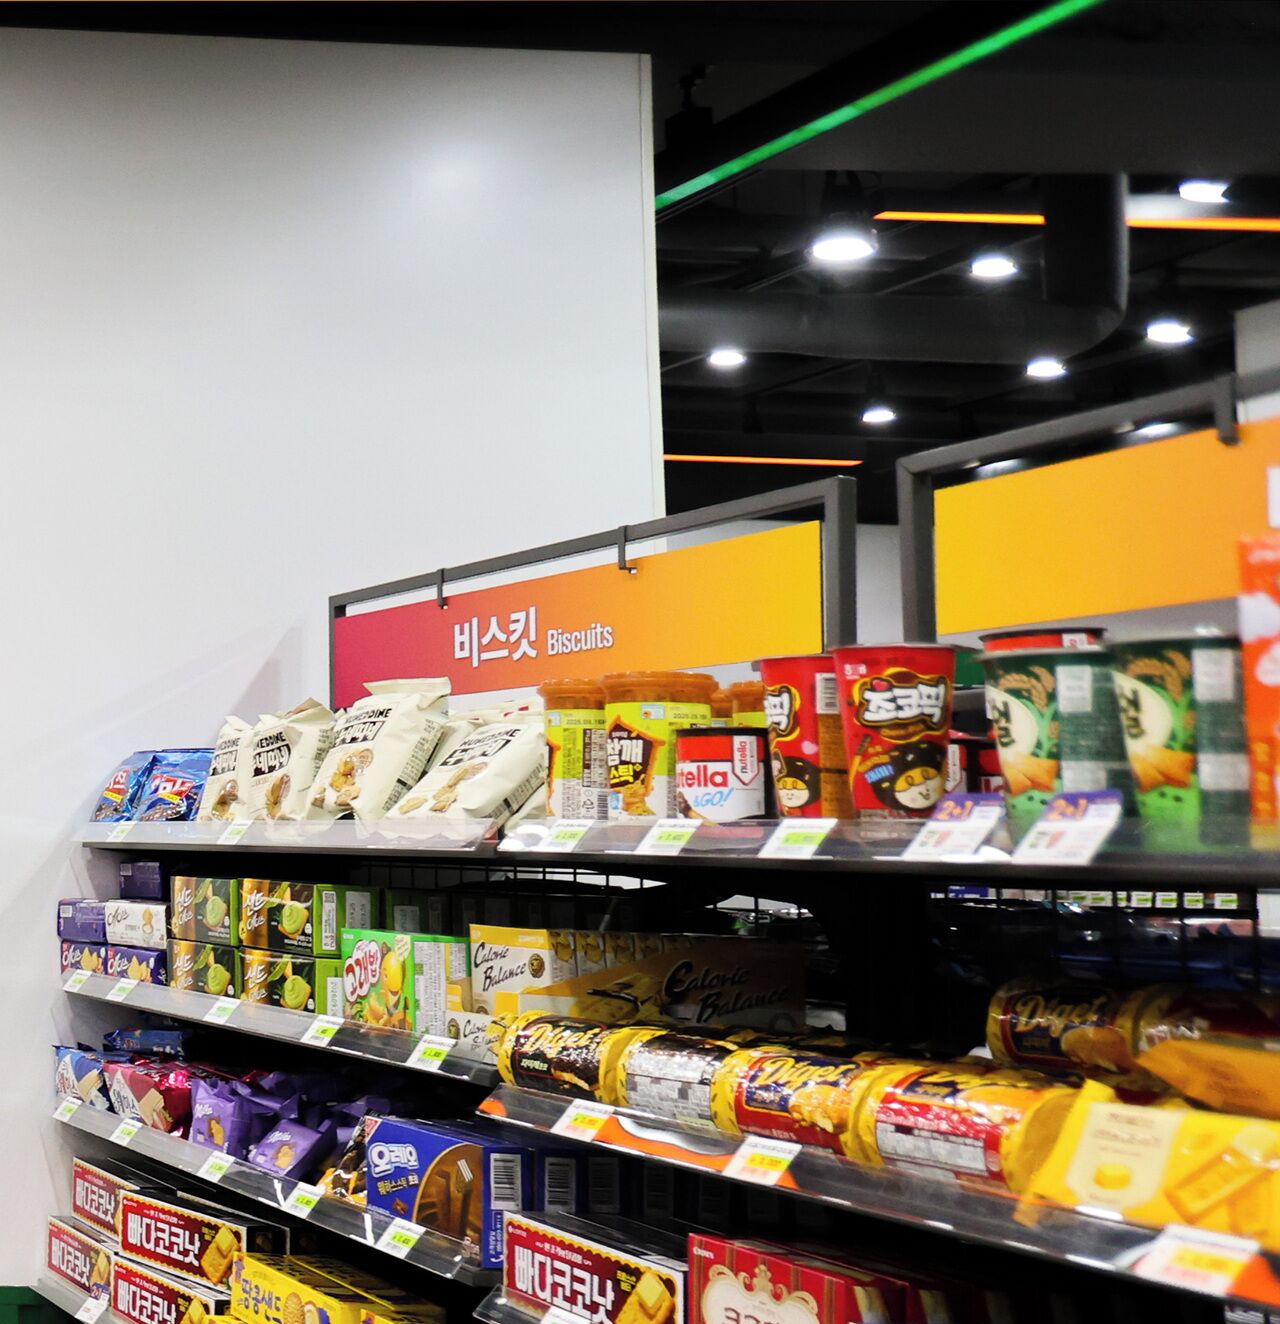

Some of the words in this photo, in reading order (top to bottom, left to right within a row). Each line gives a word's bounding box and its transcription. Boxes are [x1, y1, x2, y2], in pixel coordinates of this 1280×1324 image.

[453, 605, 540, 668] 비스킷
[546, 623, 614, 656] Biscuits
[473, 942, 511, 967] Calorie
[483, 959, 528, 993] Balance
[369, 1141, 420, 1179] 오레오
[75, 1182, 116, 1225] 빠다코코낫
[126, 1213, 202, 1265] 빠다코코낫
[50, 1238, 90, 1289] 빠다코코낫
